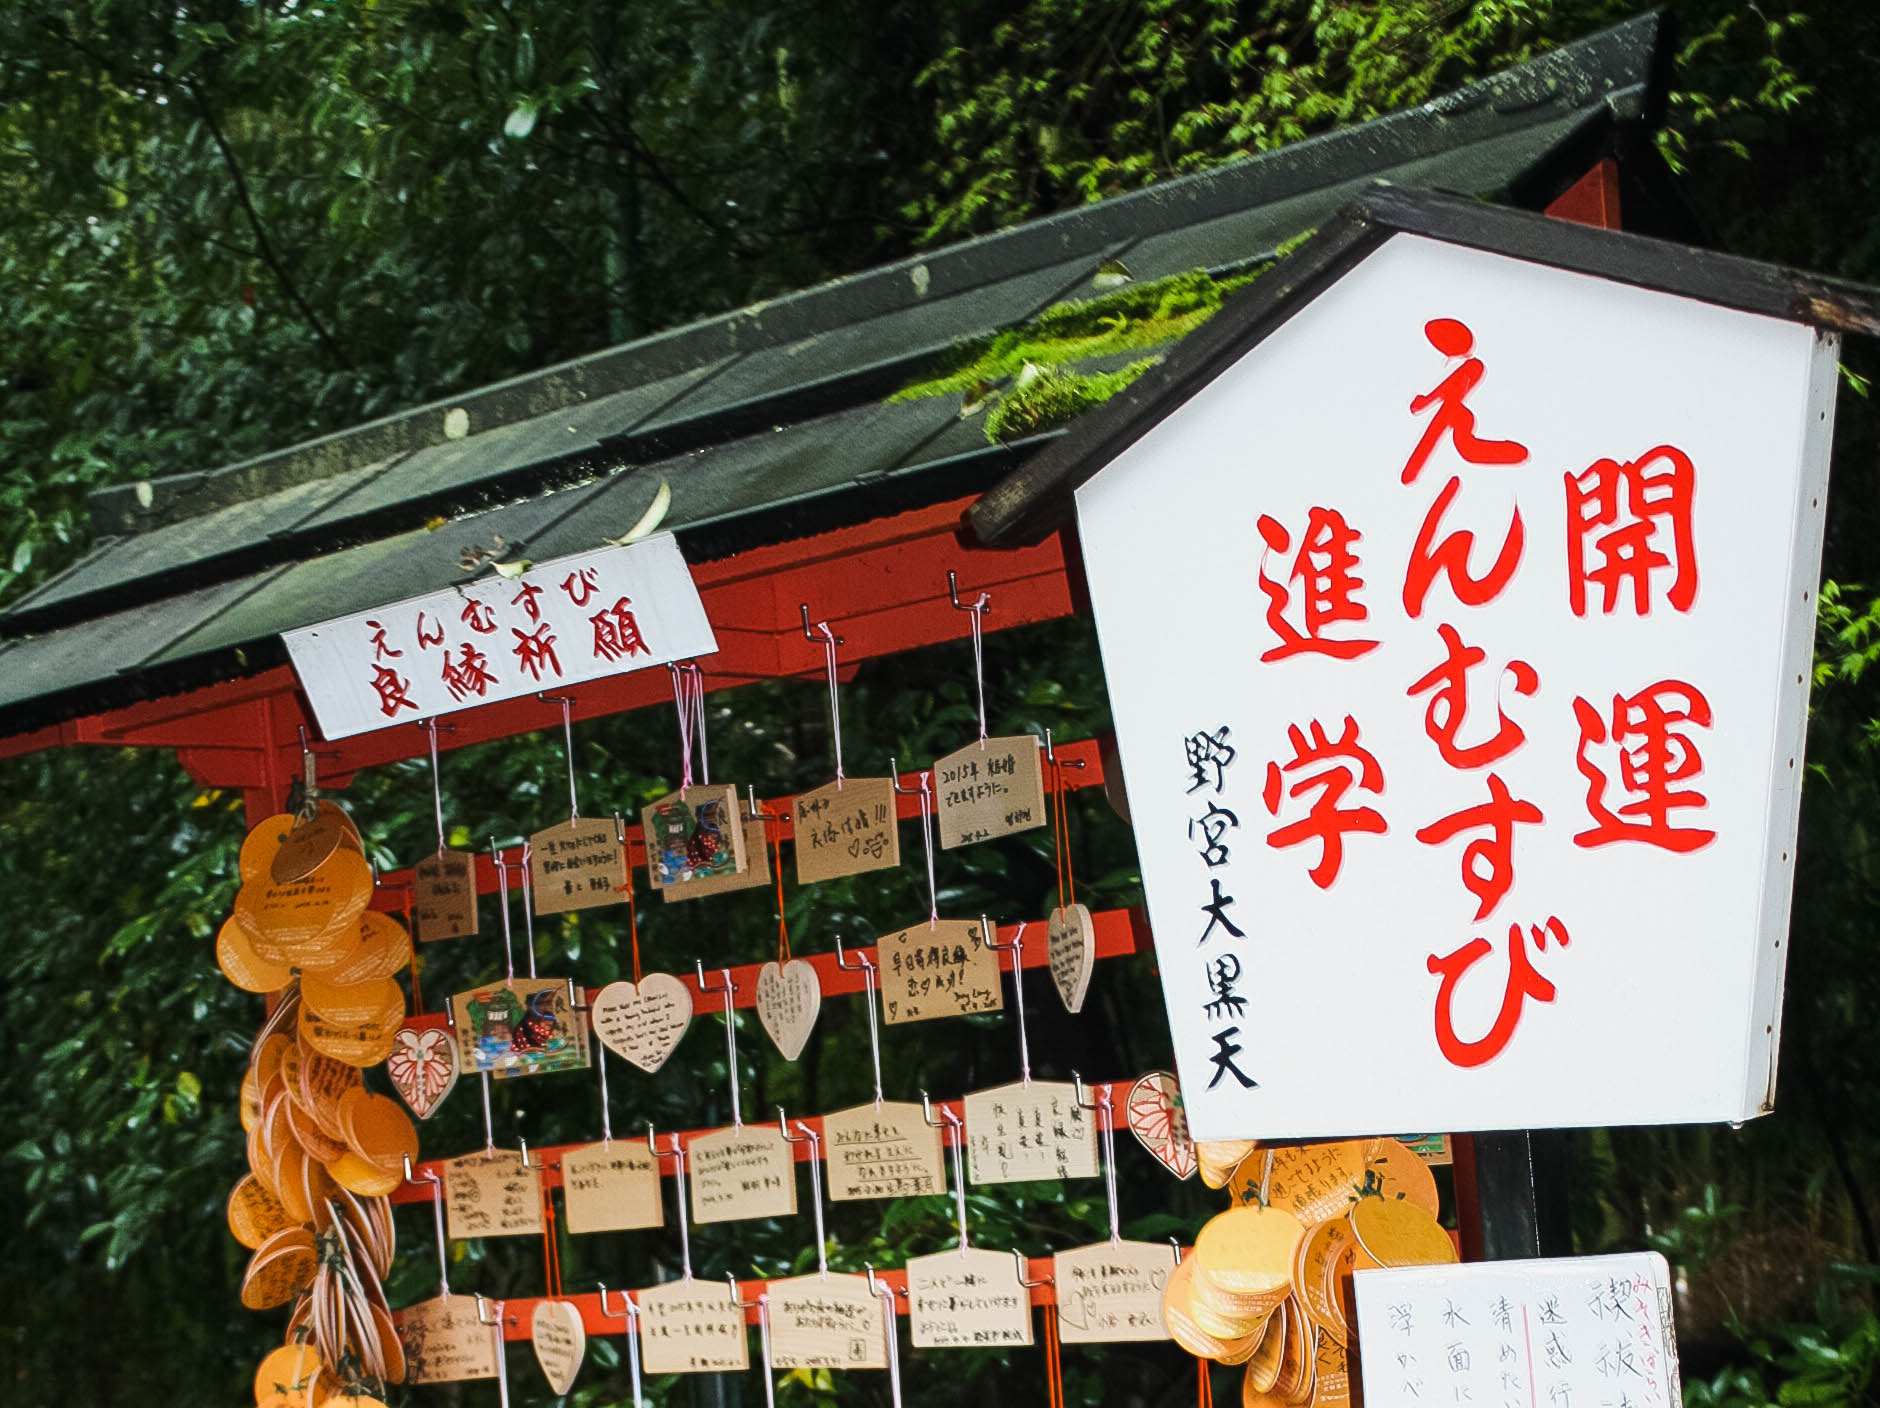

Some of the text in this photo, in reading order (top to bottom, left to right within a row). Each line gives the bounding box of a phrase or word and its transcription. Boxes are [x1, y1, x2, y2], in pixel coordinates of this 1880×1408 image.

[365, 566, 600, 661] えんむすび
[368, 595, 652, 718] 良縁祈願
[1255, 505, 1391, 890] 進学
[1399, 316, 1573, 1068] えんむすび
[1564, 444, 1717, 853] 開運
[1182, 724, 1262, 1092] 野宮大黒天
